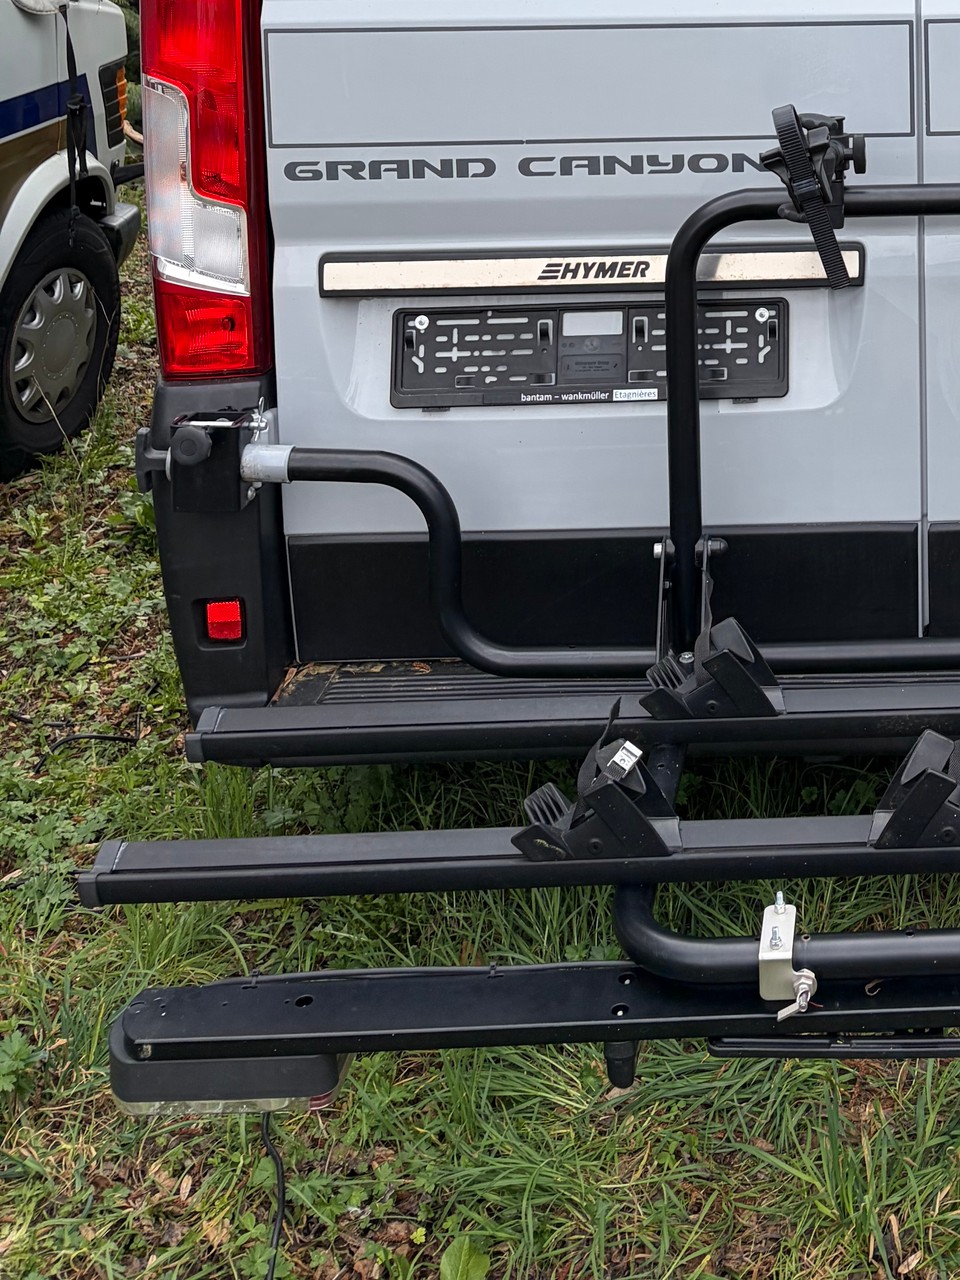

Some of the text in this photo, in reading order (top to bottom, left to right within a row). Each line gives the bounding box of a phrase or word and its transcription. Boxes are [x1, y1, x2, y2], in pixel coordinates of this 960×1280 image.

[283, 152, 768, 182] GRAND CANYON
[560, 260, 651, 280] HYMER
[520, 393, 553, 402] bantam
[561, 391, 610, 401] wankmüller
[614, 389, 657, 400] Etagnières
